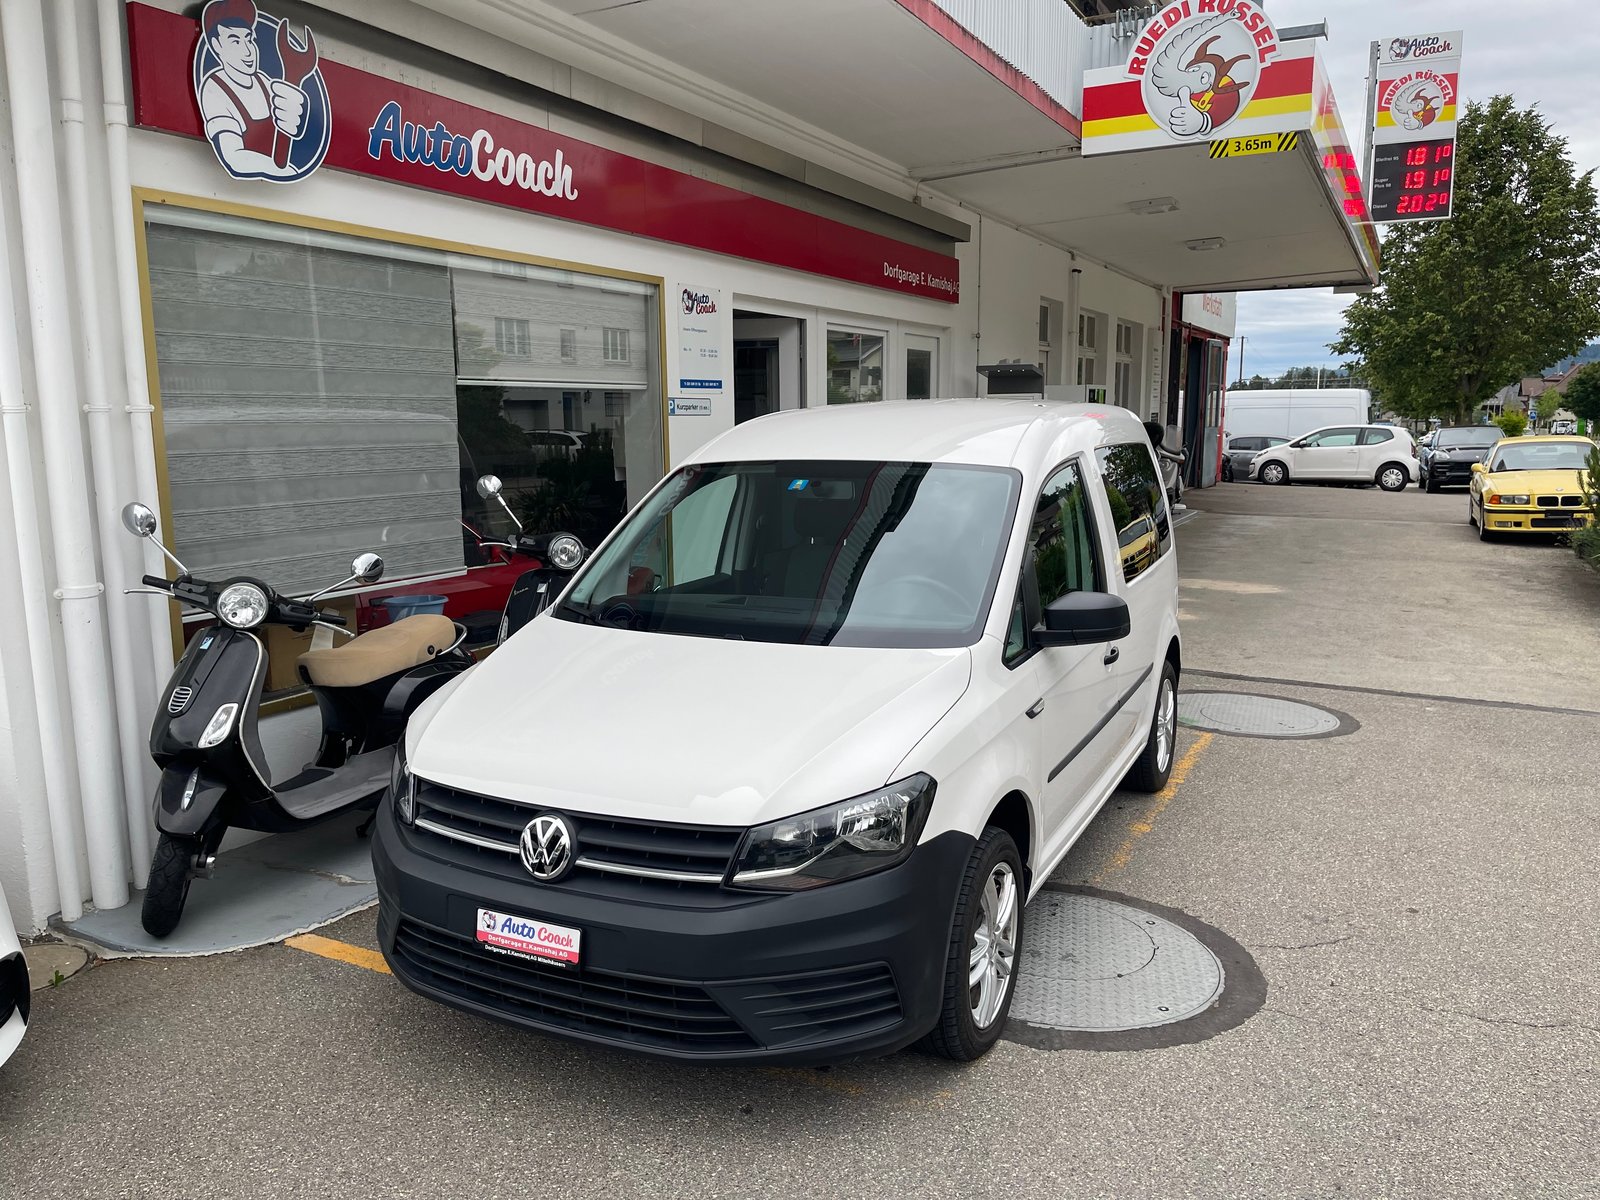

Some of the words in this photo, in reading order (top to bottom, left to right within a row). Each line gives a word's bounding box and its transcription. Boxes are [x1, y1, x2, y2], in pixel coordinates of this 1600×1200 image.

[1128, 0, 1191, 75] RUEDI
[1410, 37, 1439, 49] Auto
[1413, 41, 1452, 57] Coach
[1384, 74, 1413, 106] RUEDI
[1415, 70, 1453, 101] RÜSSEL
[1233, 139, 1272, 152] 3.65m
[884, 262, 920, 286] Dorfgarage
[921, 272, 926, 285] E.
[693, 293, 710, 305] Auto
[696, 301, 717, 315] Coach
[500, 917, 535, 939] Auto
[537, 927, 574, 948] Coach
[488, 934, 521, 948] Dorfgarage
[485, 944, 507, 954] Dorfgarage
